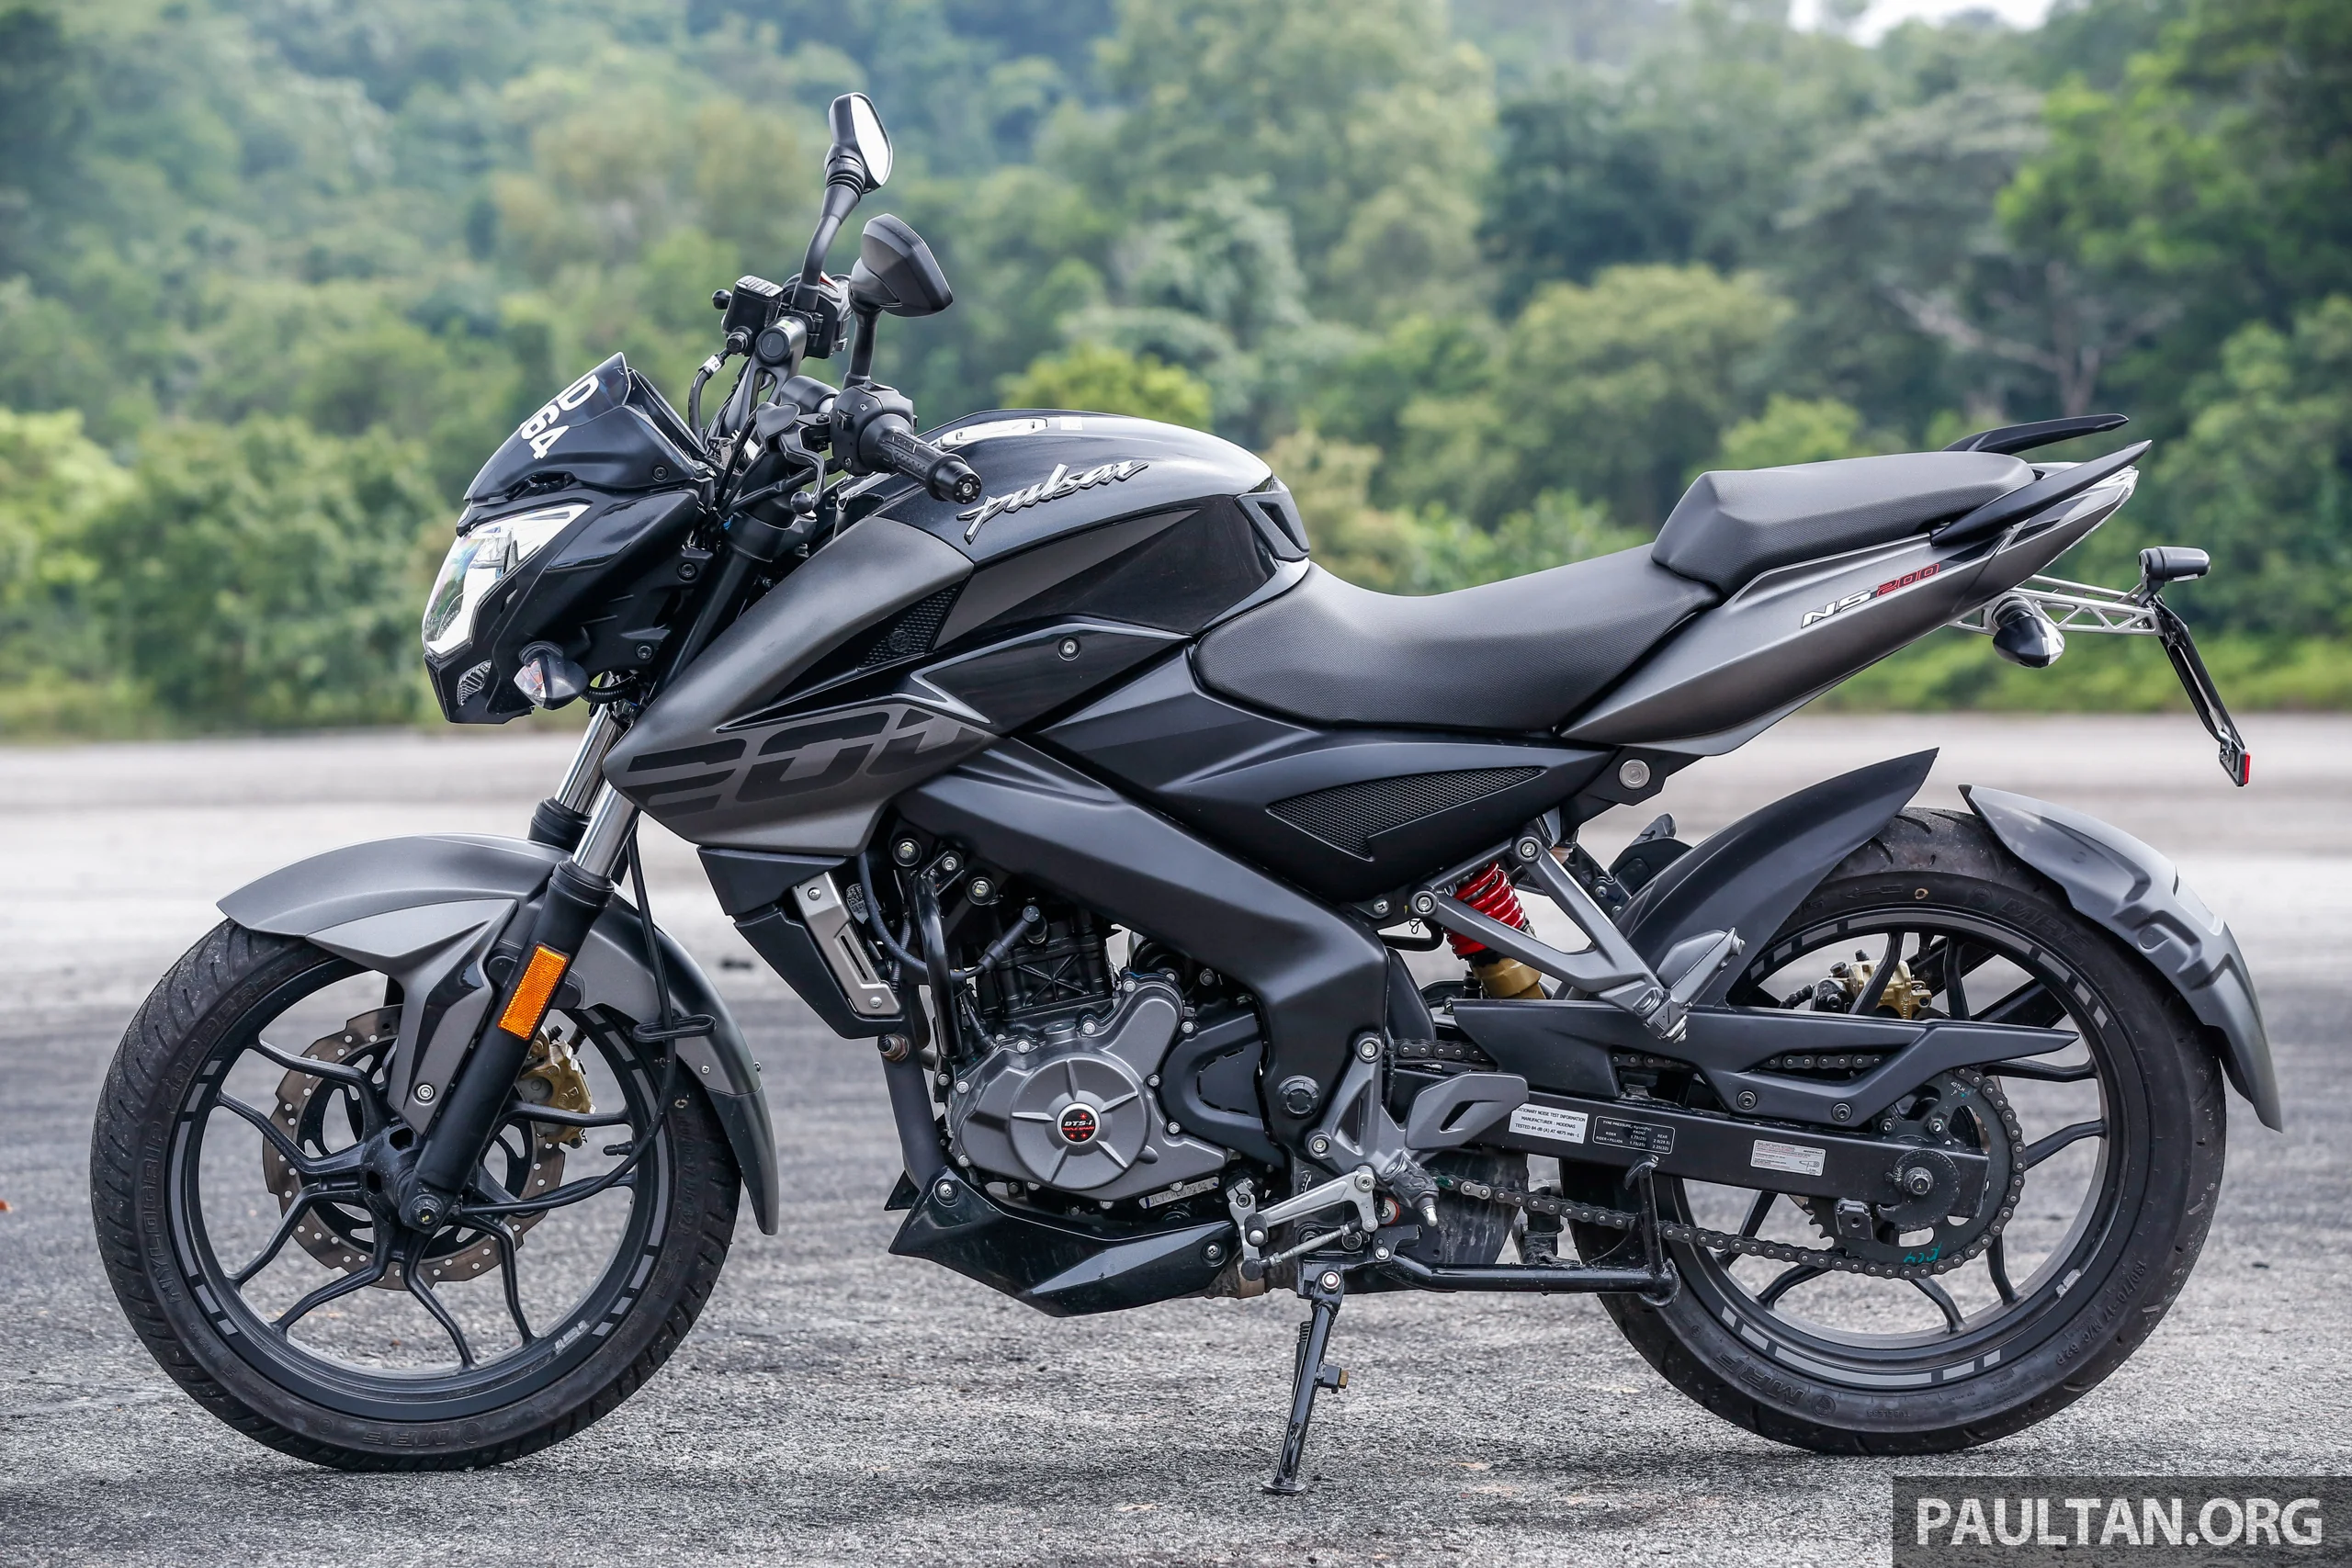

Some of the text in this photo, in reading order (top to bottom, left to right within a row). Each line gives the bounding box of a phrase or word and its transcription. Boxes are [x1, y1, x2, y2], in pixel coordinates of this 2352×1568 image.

[956, 460, 1150, 545] pulsar
[1517, 1107, 1538, 1115] ATIONARY
[1559, 1113, 1586, 1122] INFORMATION
[1521, 1115, 1553, 1125] MANUFACTURER
[1712, 1352, 1810, 1408] MRF
[1866, 1409, 1912, 1419] TUBELESS
